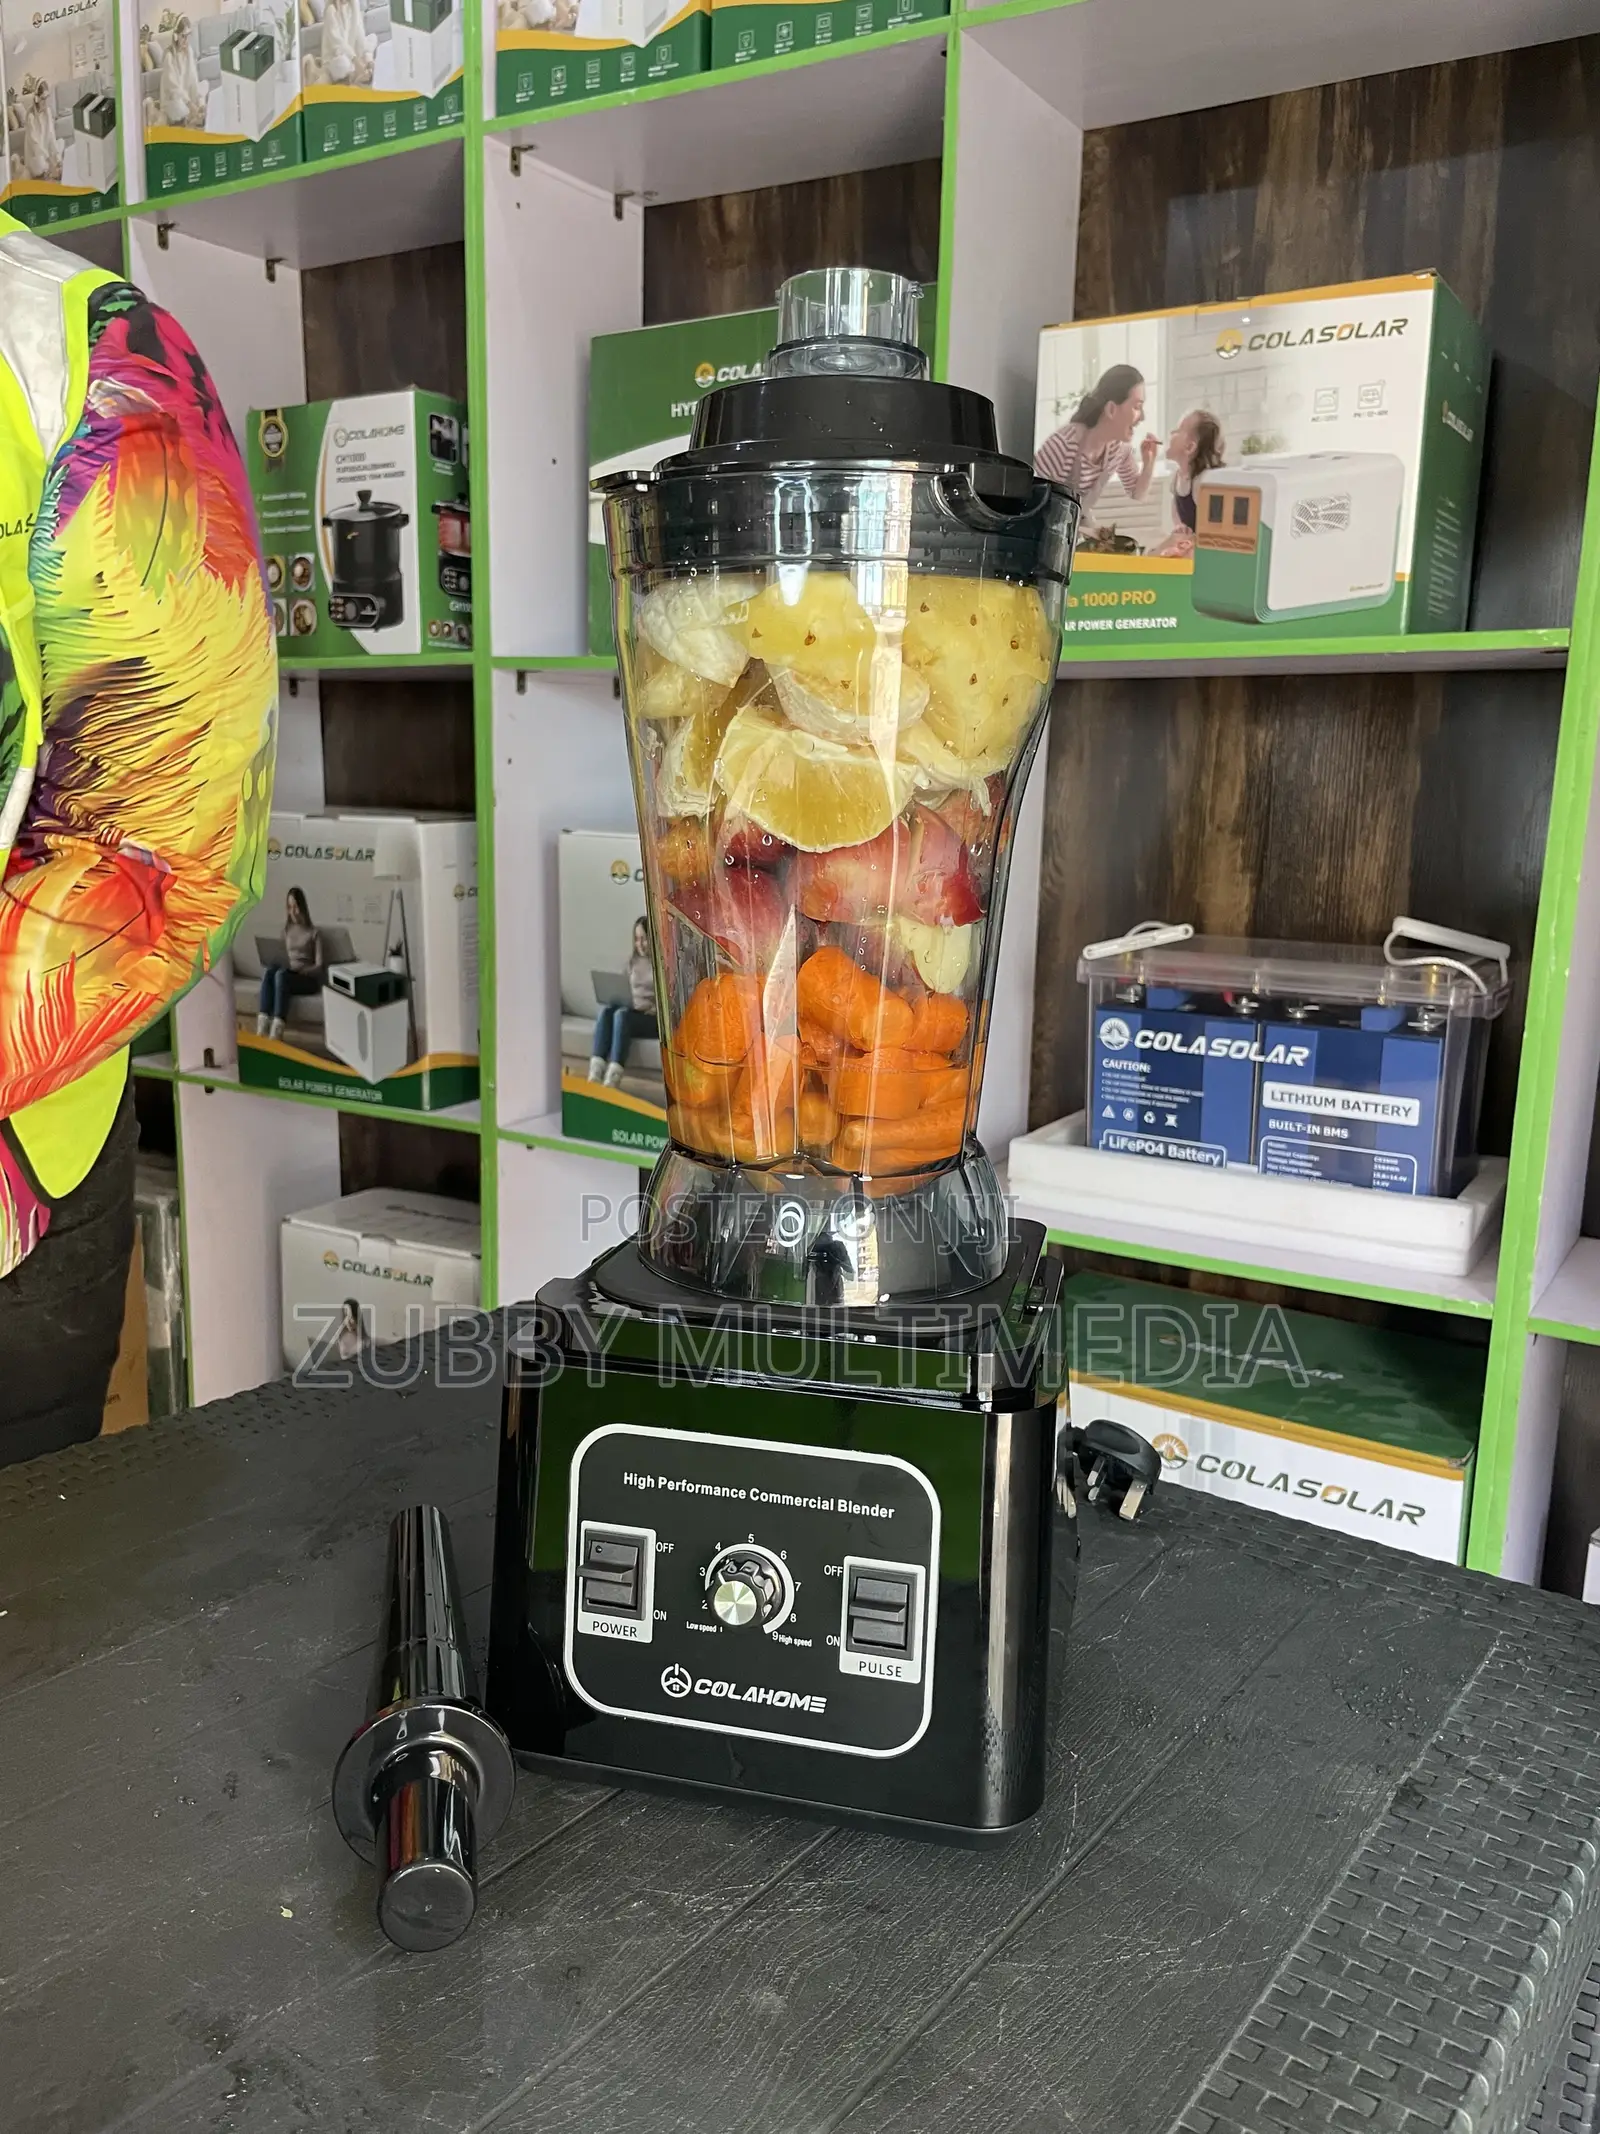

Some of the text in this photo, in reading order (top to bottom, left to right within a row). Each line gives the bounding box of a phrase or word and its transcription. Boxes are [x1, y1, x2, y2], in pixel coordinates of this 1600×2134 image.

[43, 0, 98, 23] COLASOLAR
[1247, 318, 1408, 352] COLASOLAR
[716, 362, 766, 383] COLA
[1081, 592, 1119, 607] 1000
[1121, 590, 1157, 606] PRO
[1077, 619, 1113, 631] POWER
[1115, 617, 1177, 630] GENERATOR
[284, 845, 376, 862] COLASOLAR
[1134, 1029, 1310, 1066] COLASOLAR
[1102, 1058, 1152, 1073] CAUTION:
[278, 1077, 383, 1101] SOLAR POWER GENERATOR
[1271, 1090, 1412, 1118] LITHIUM BATTERY
[612, 1129, 644, 1146] SOLAR
[1268, 1119, 1349, 1139] BUILT-IN BMS
[1108, 1135, 1221, 1167] LiFePO4 Battery
[342, 1259, 434, 1288] COLASOLAR
[623, 1471, 896, 1519] High Performance Commercial Blender
[1196, 1453, 1426, 1527] COLASOLAR
[714, 1541, 722, 1551] 4
[748, 1533, 755, 1544] 5
[656, 1541, 675, 1554] OFF
[780, 1550, 788, 1561] 6
[699, 1566, 706, 1577] 3
[823, 1564, 843, 1577] OFF
[795, 1581, 802, 1592] 7
[701, 1599, 708, 1610] 2
[653, 1610, 667, 1621] ON
[790, 1612, 797, 1623] 8
[592, 1620, 638, 1638] POWER
[686, 1621, 699, 1630] Low
[699, 1623, 717, 1633] speed
[772, 1631, 812, 1647] 9 High speed
[825, 1635, 841, 1646] ON
[859, 1660, 902, 1678] PULSE
[694, 1677, 828, 1714] COLAHOME
